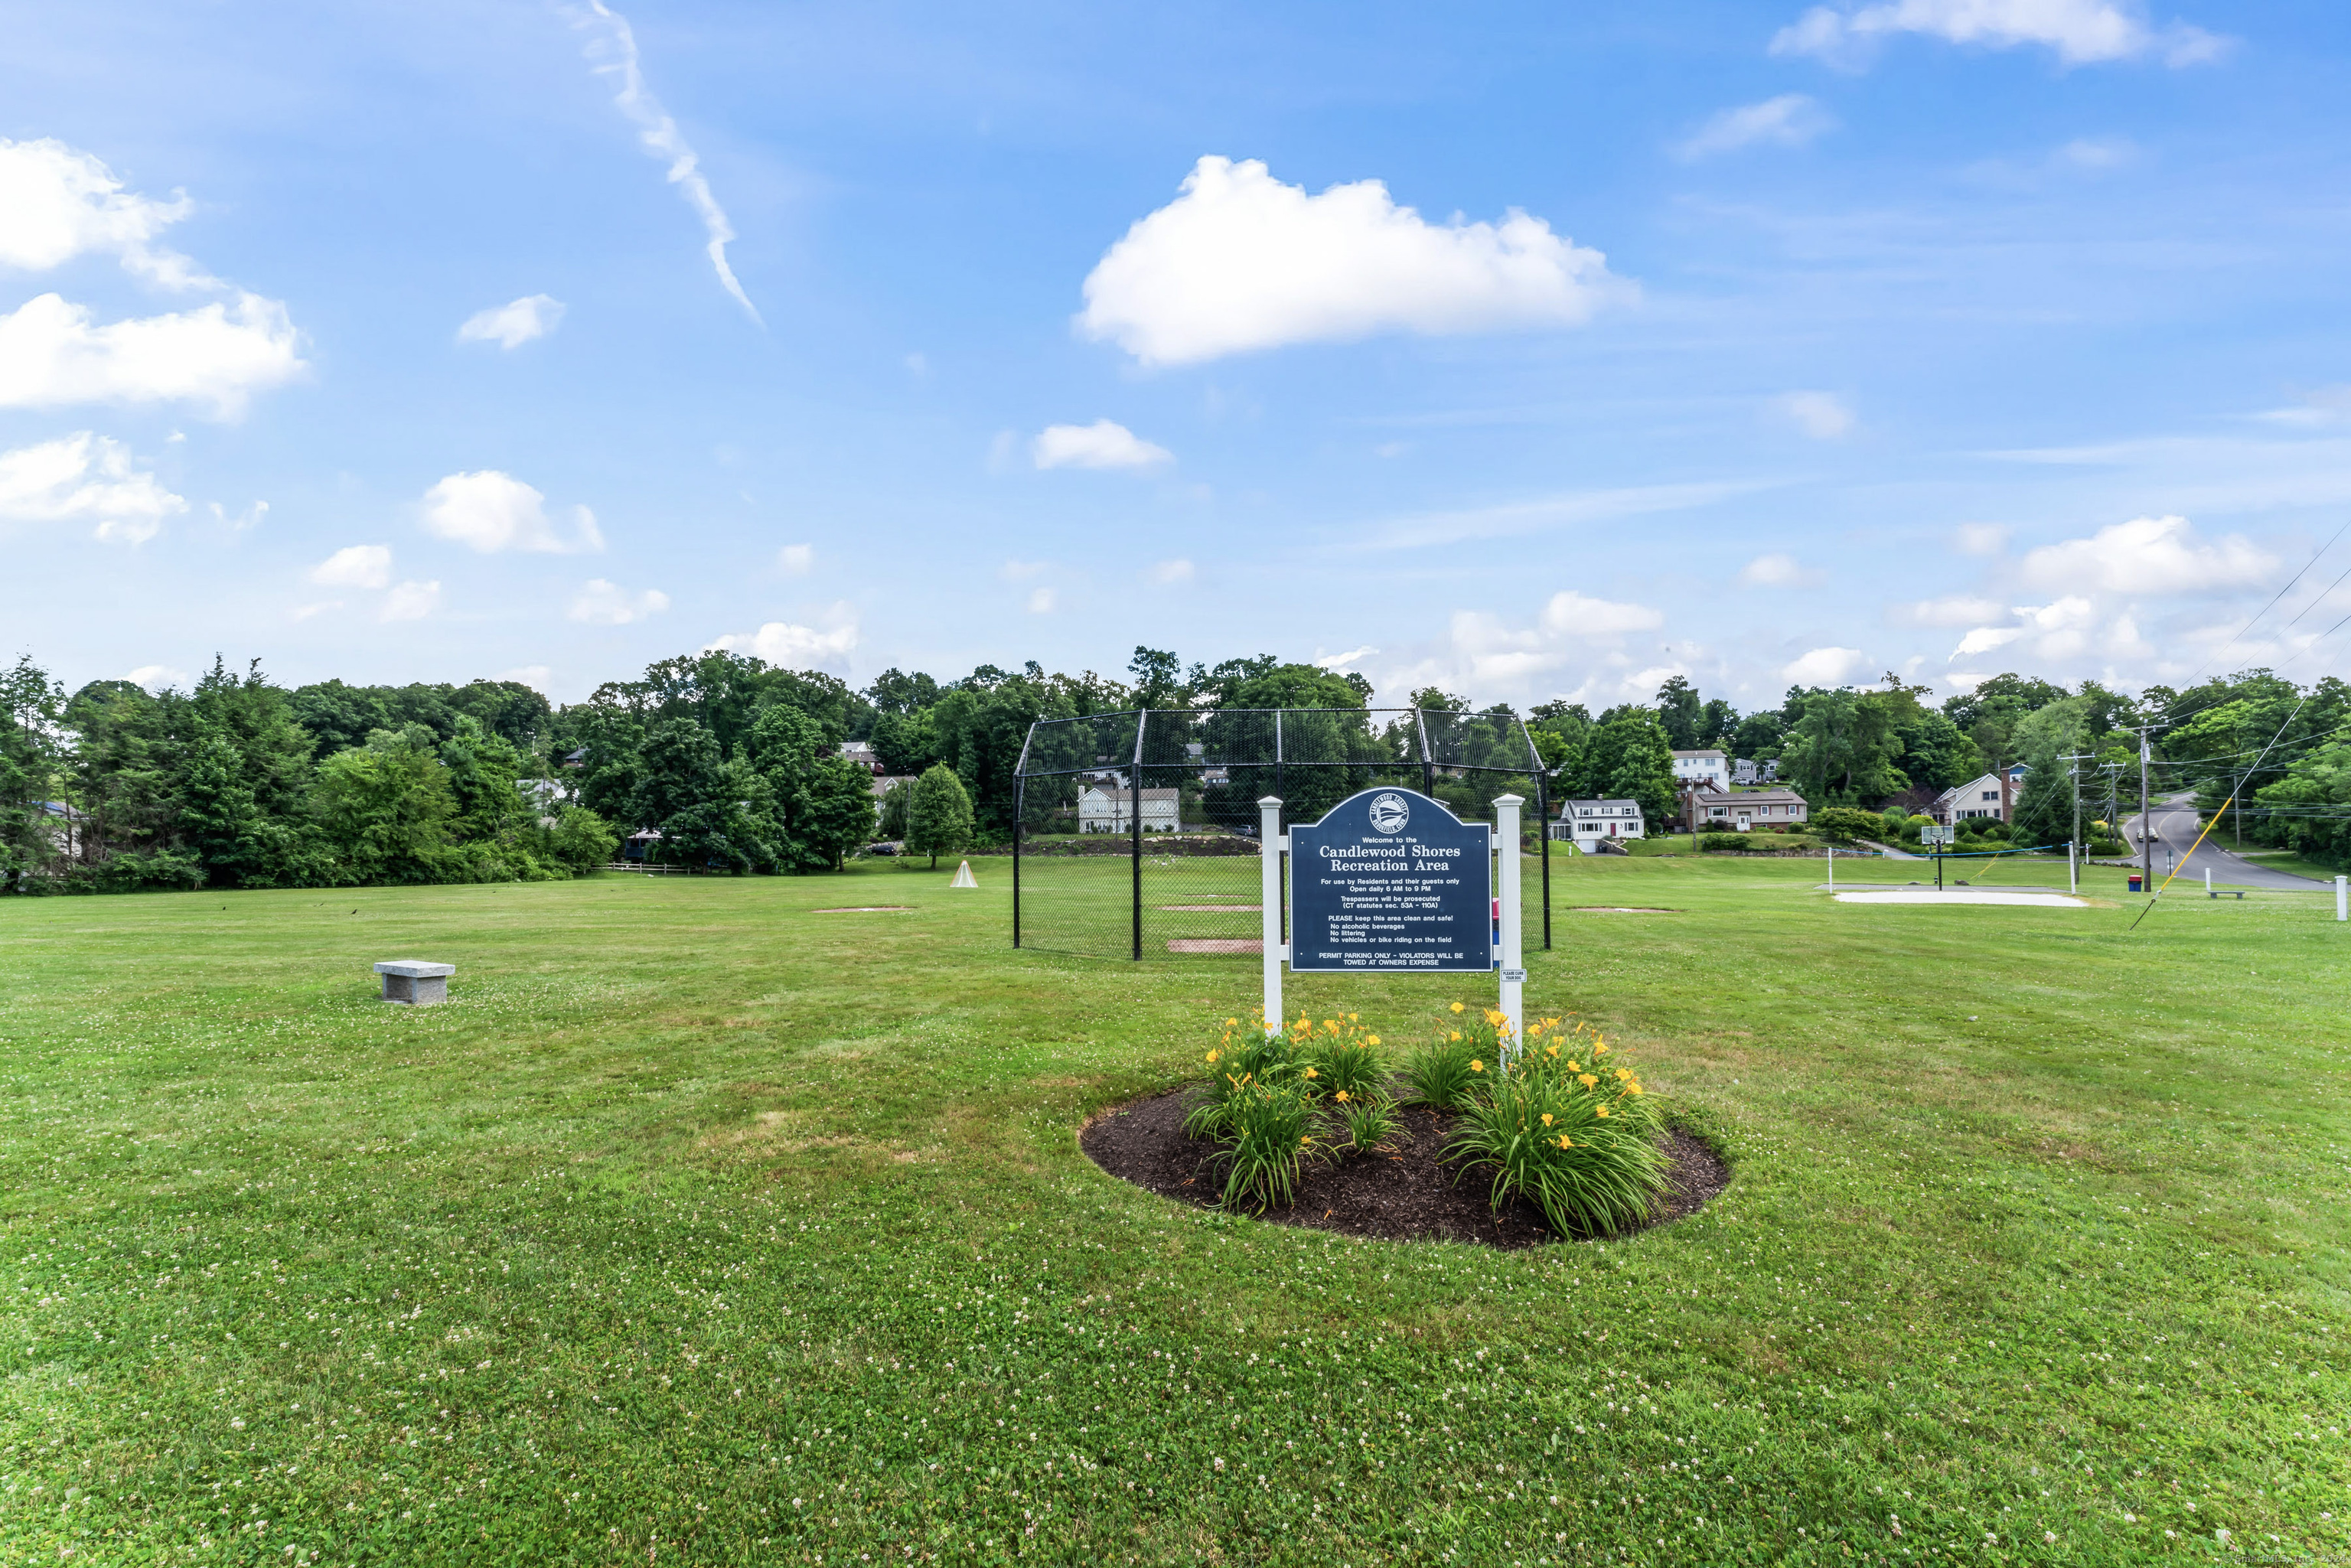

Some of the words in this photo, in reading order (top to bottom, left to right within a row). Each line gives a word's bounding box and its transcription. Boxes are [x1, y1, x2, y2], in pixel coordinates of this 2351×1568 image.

[1319, 845, 1405, 857] Candlewood
[1412, 845, 1460, 857] Shores
[1331, 859, 1408, 871] Recreation
[1414, 859, 1449, 871] Area
